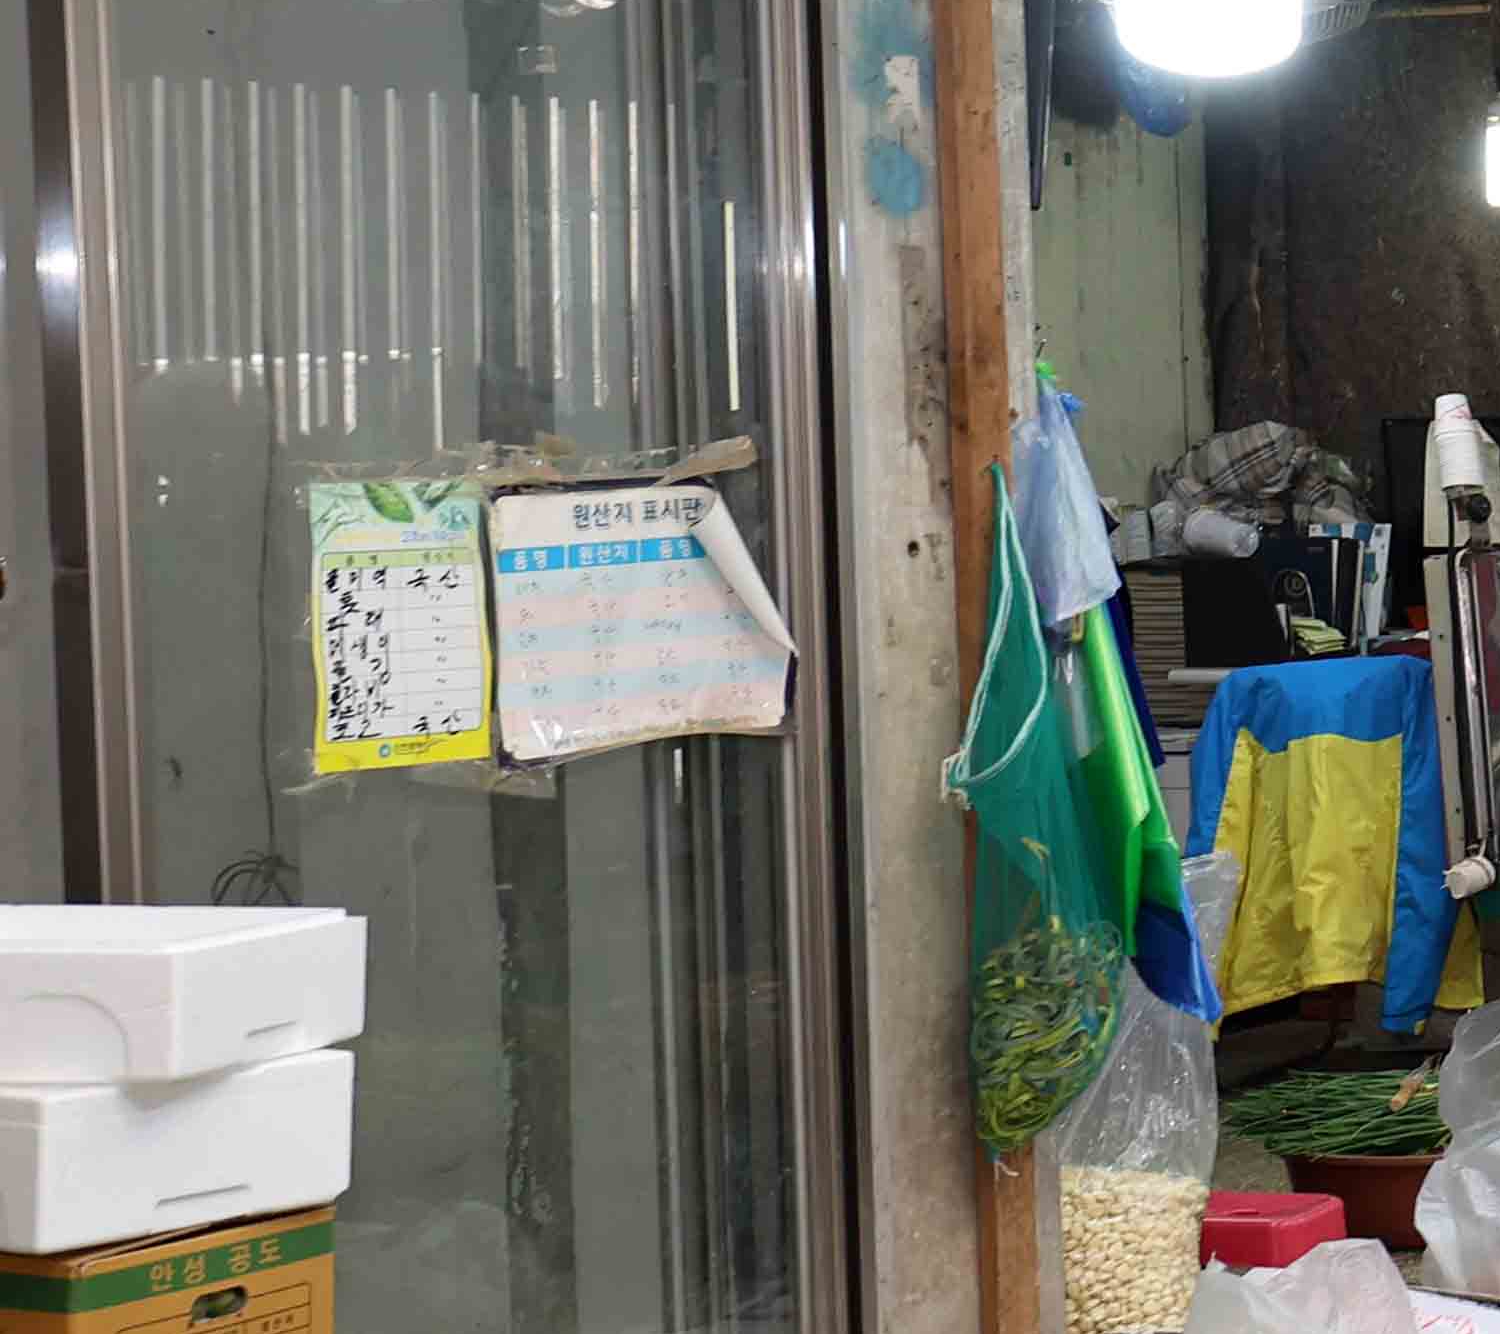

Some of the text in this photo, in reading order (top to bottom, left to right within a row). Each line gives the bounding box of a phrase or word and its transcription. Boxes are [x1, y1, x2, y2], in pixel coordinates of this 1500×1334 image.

[573, 496, 704, 530] 원산지 표시판
[152, 1236, 282, 1293] 안성 공도
